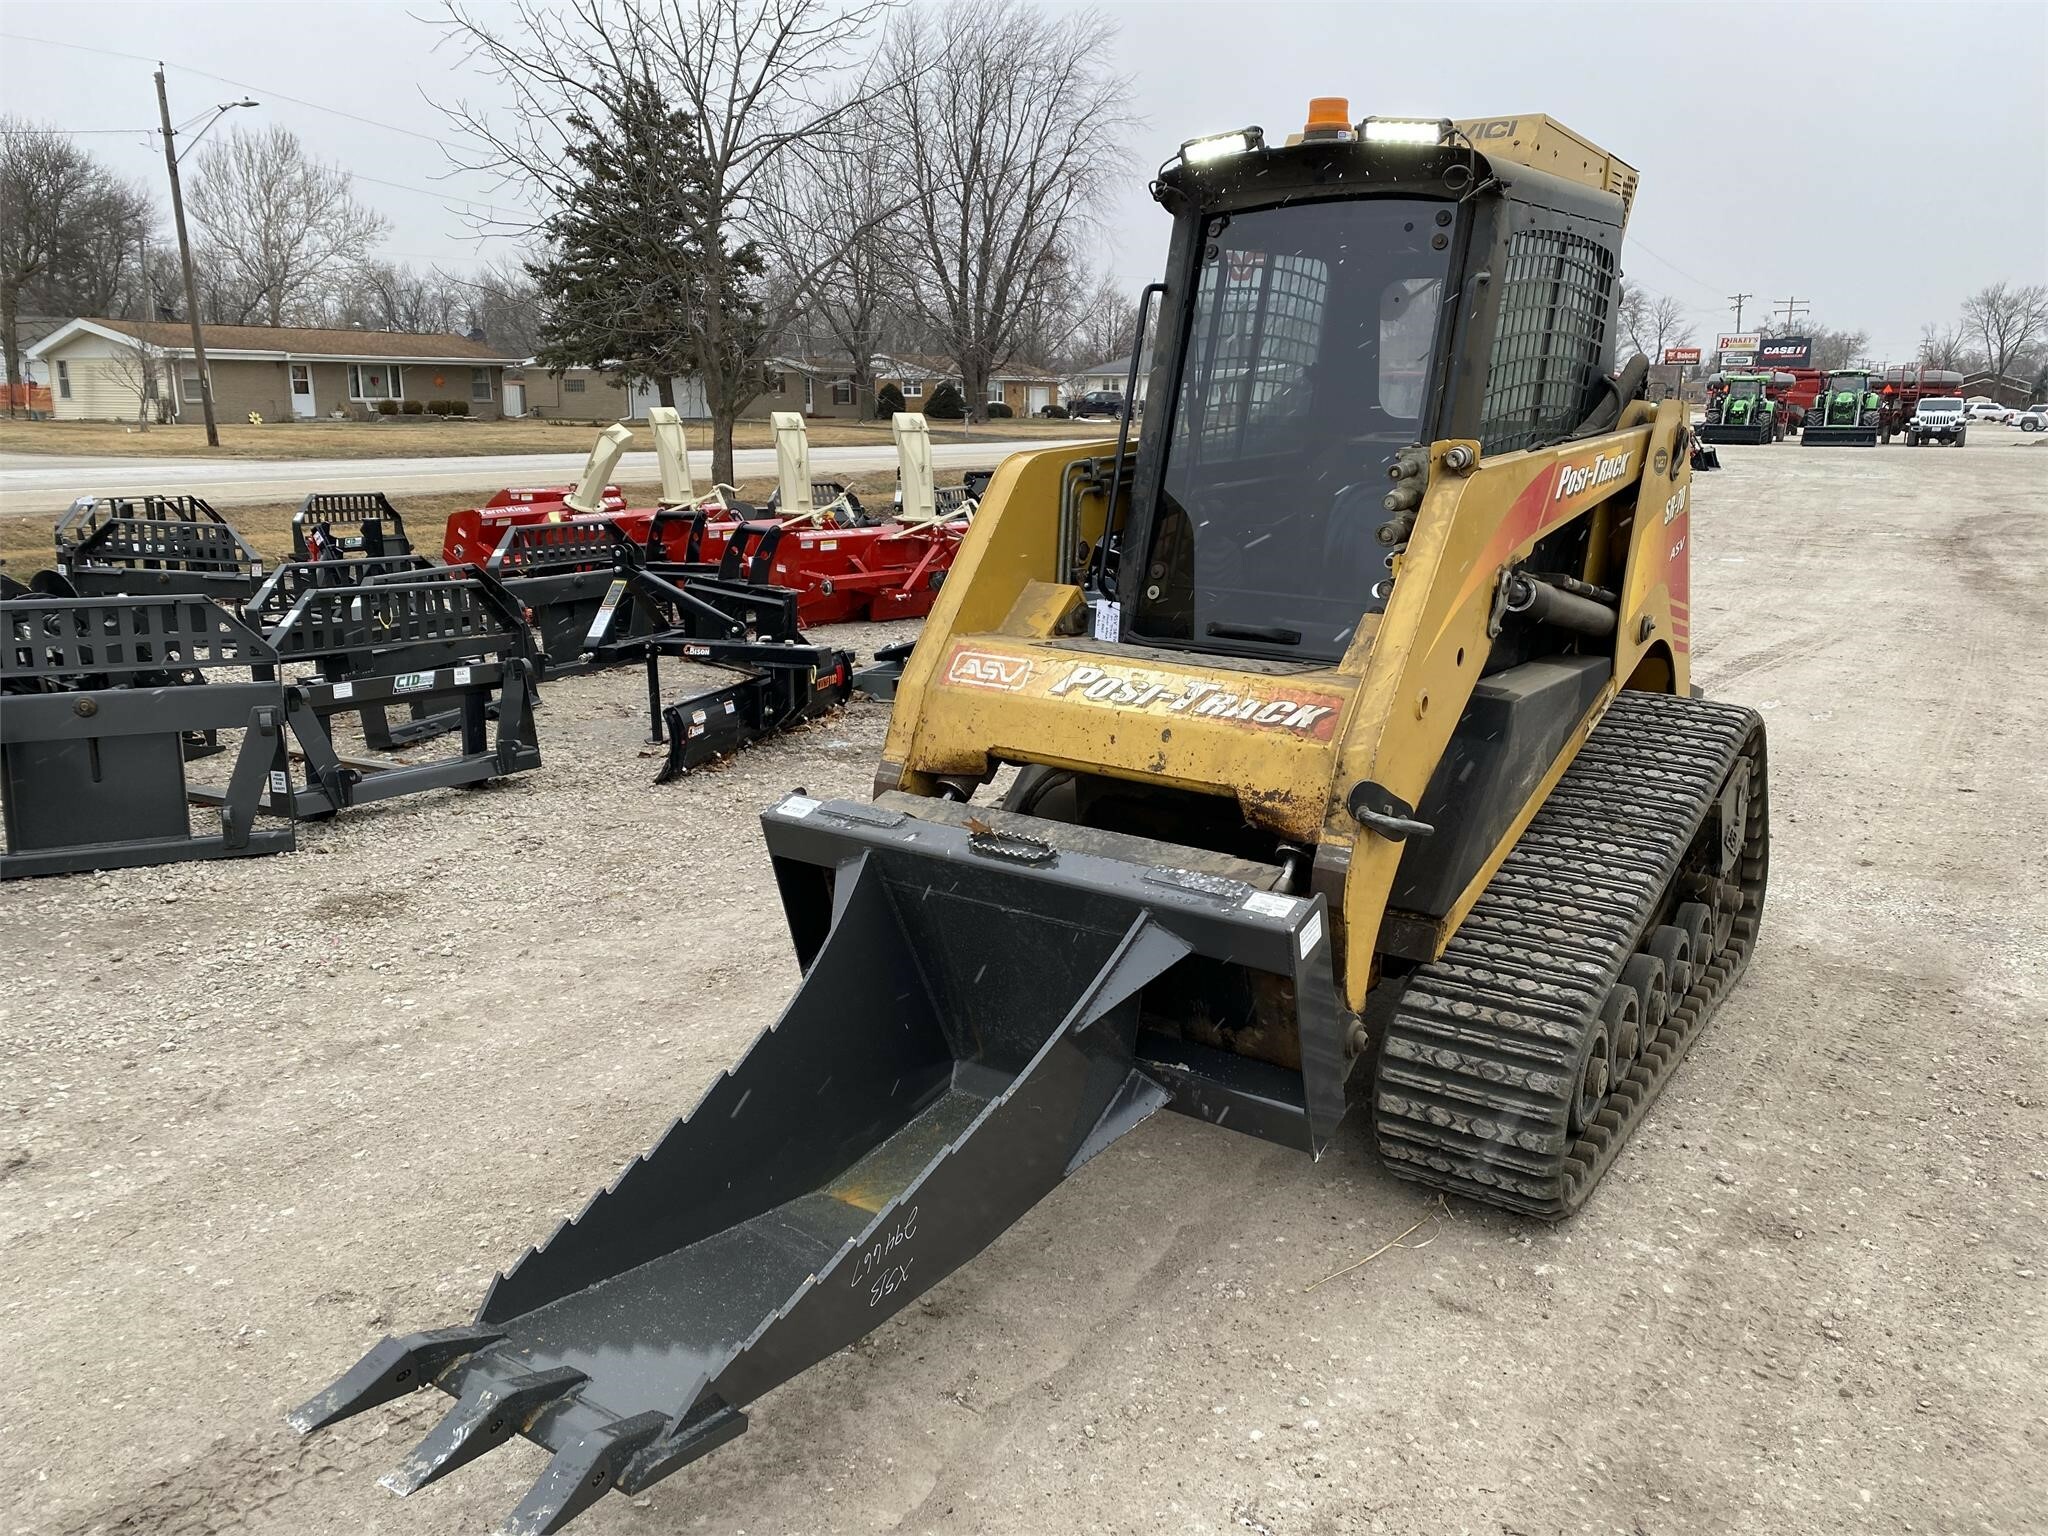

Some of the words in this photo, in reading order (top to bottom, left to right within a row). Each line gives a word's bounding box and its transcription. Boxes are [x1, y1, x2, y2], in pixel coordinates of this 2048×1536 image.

[1677, 351, 1698, 360] Bobcat
[1763, 346, 1796, 355] CASE
[505, 505, 531, 513] King
[1669, 536, 1686, 562] ASV
[956, 659, 1028, 683] ASV
[396, 674, 420, 688] CID
